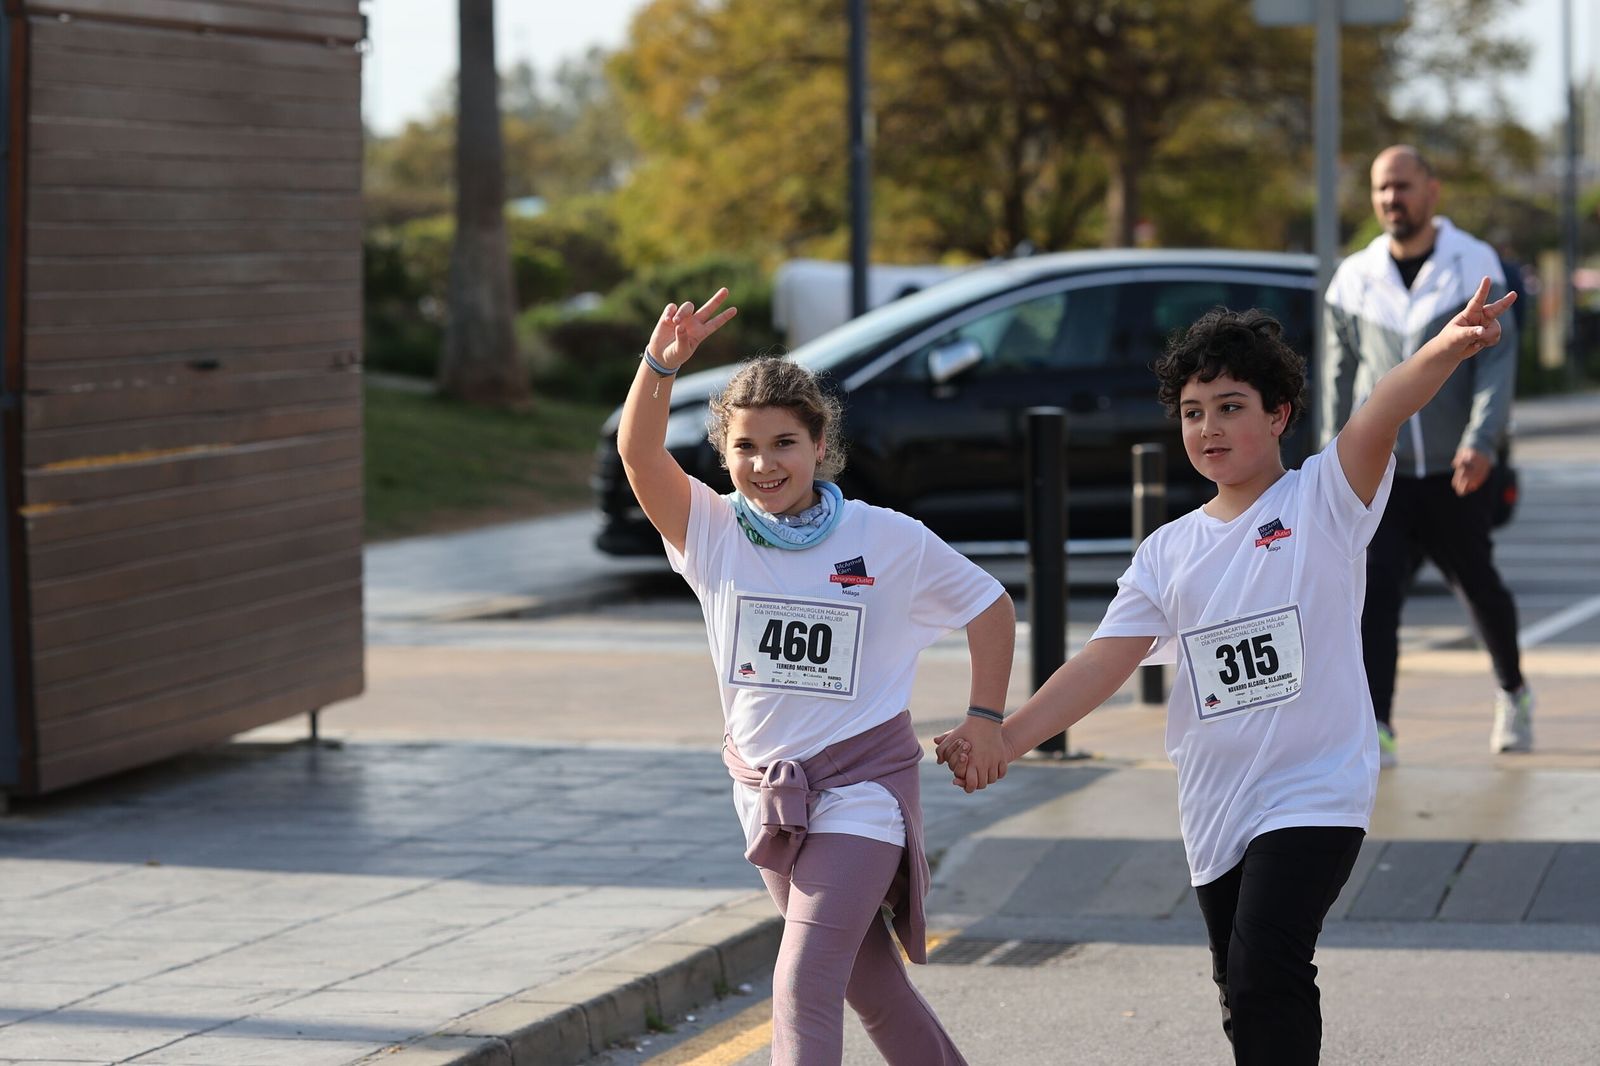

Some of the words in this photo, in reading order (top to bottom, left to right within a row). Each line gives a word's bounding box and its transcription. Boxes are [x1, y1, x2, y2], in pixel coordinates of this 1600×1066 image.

[836, 558, 862, 570] McArthur
[764, 610, 807, 619] INTERNACIONAL
[781, 605, 825, 614] MCARTHURGLEN
[1200, 630, 1224, 641] CARRERA
[1224, 620, 1265, 634] MCARTHURGLEN
[1211, 630, 1250, 644] INTERNACIONAL
[1267, 621, 1285, 630] MUJER
[759, 619, 832, 664] 460
[1216, 633, 1279, 685] 315
